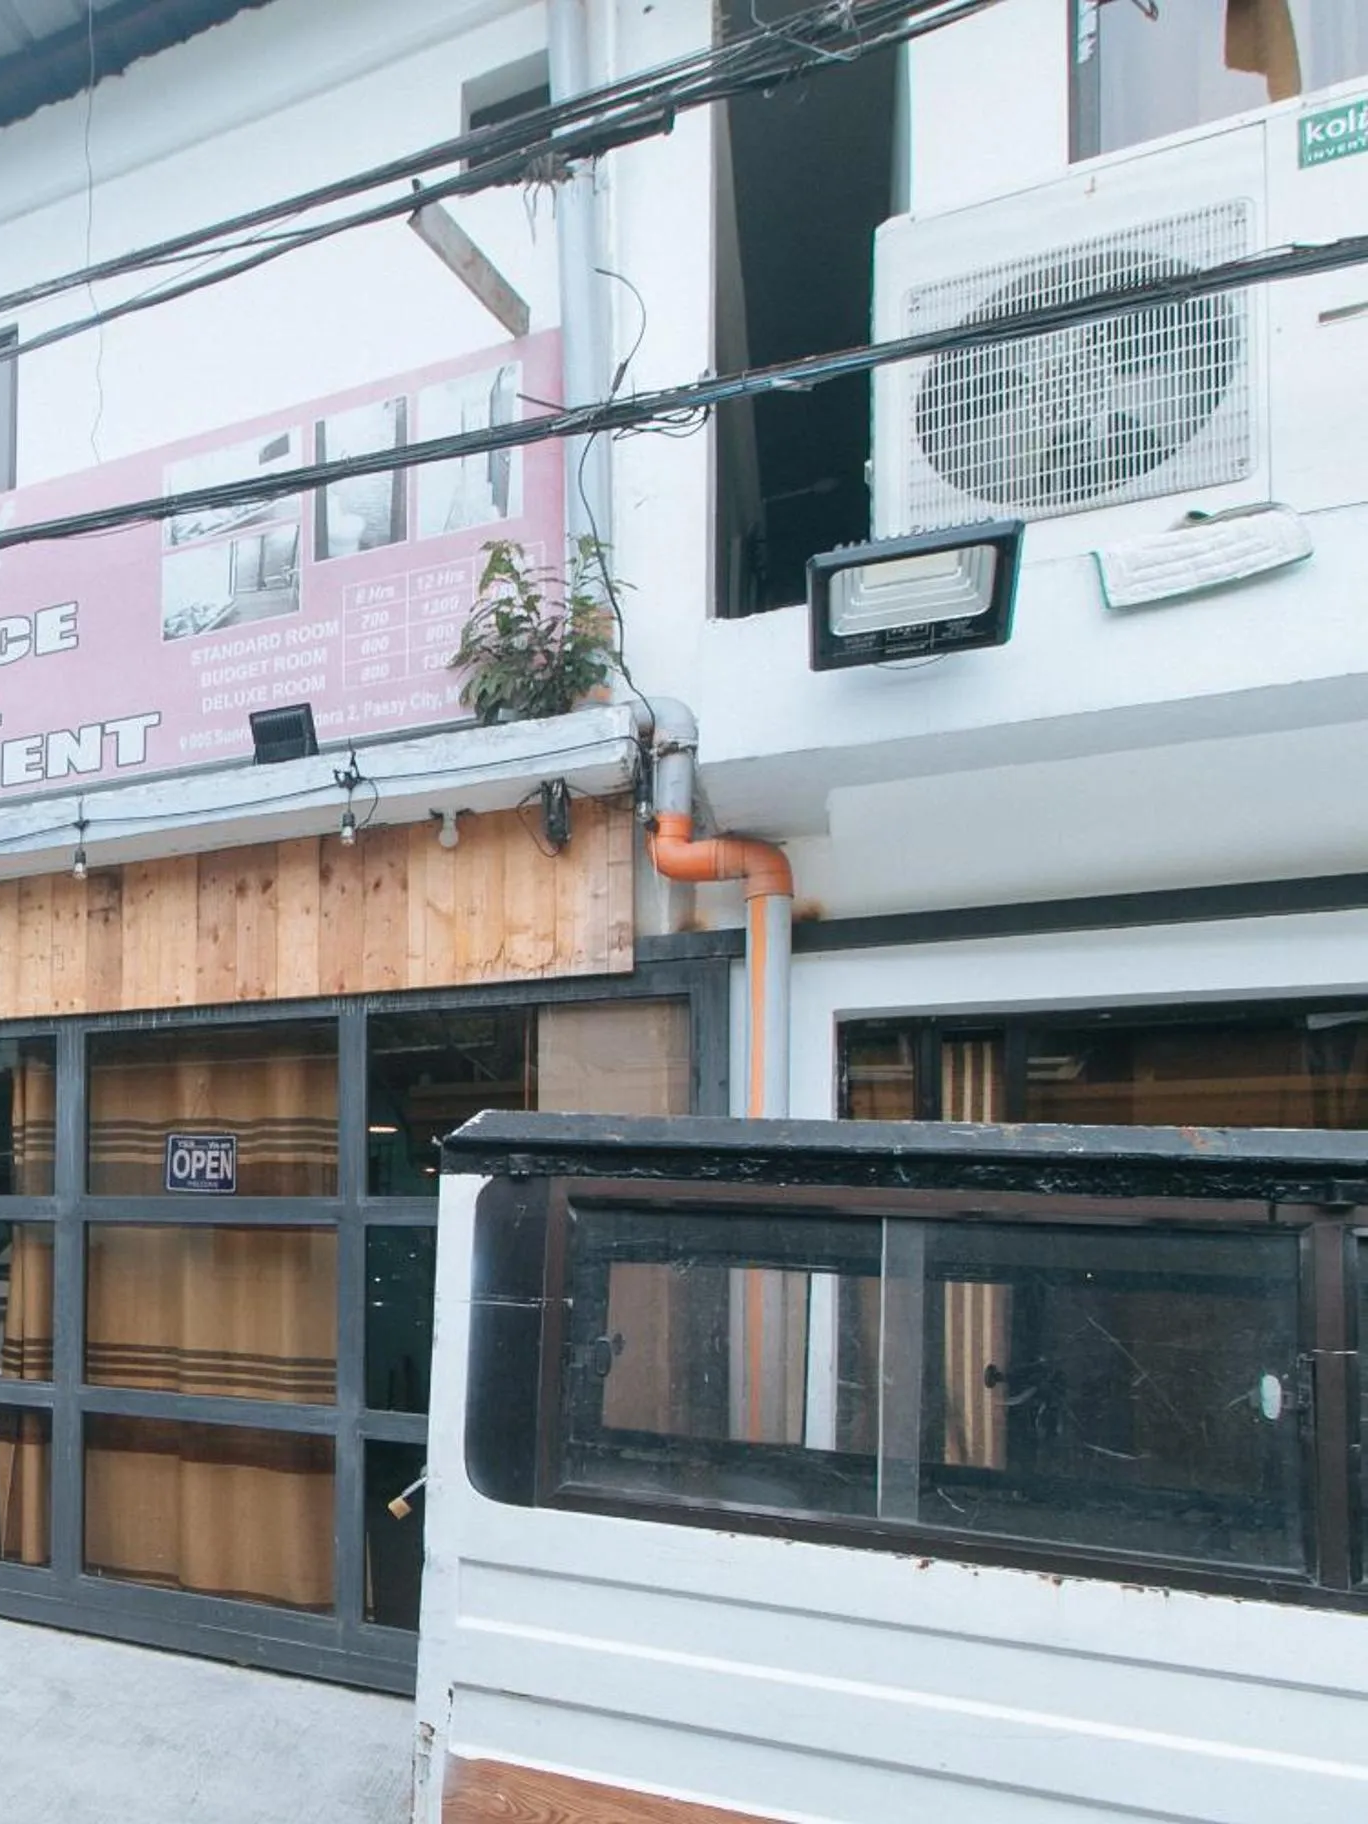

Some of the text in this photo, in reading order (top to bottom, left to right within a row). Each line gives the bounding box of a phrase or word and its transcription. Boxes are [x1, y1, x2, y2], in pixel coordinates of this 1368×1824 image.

[369, 584, 395, 602] Hrs
[436, 570, 466, 587] Hrs
[191, 620, 341, 667] STANDARD ROOM
[201, 647, 328, 688] BUDGET ROOM
[202, 674, 326, 715] DELUXE ROOM
[173, 1148, 232, 1180] OPEN
